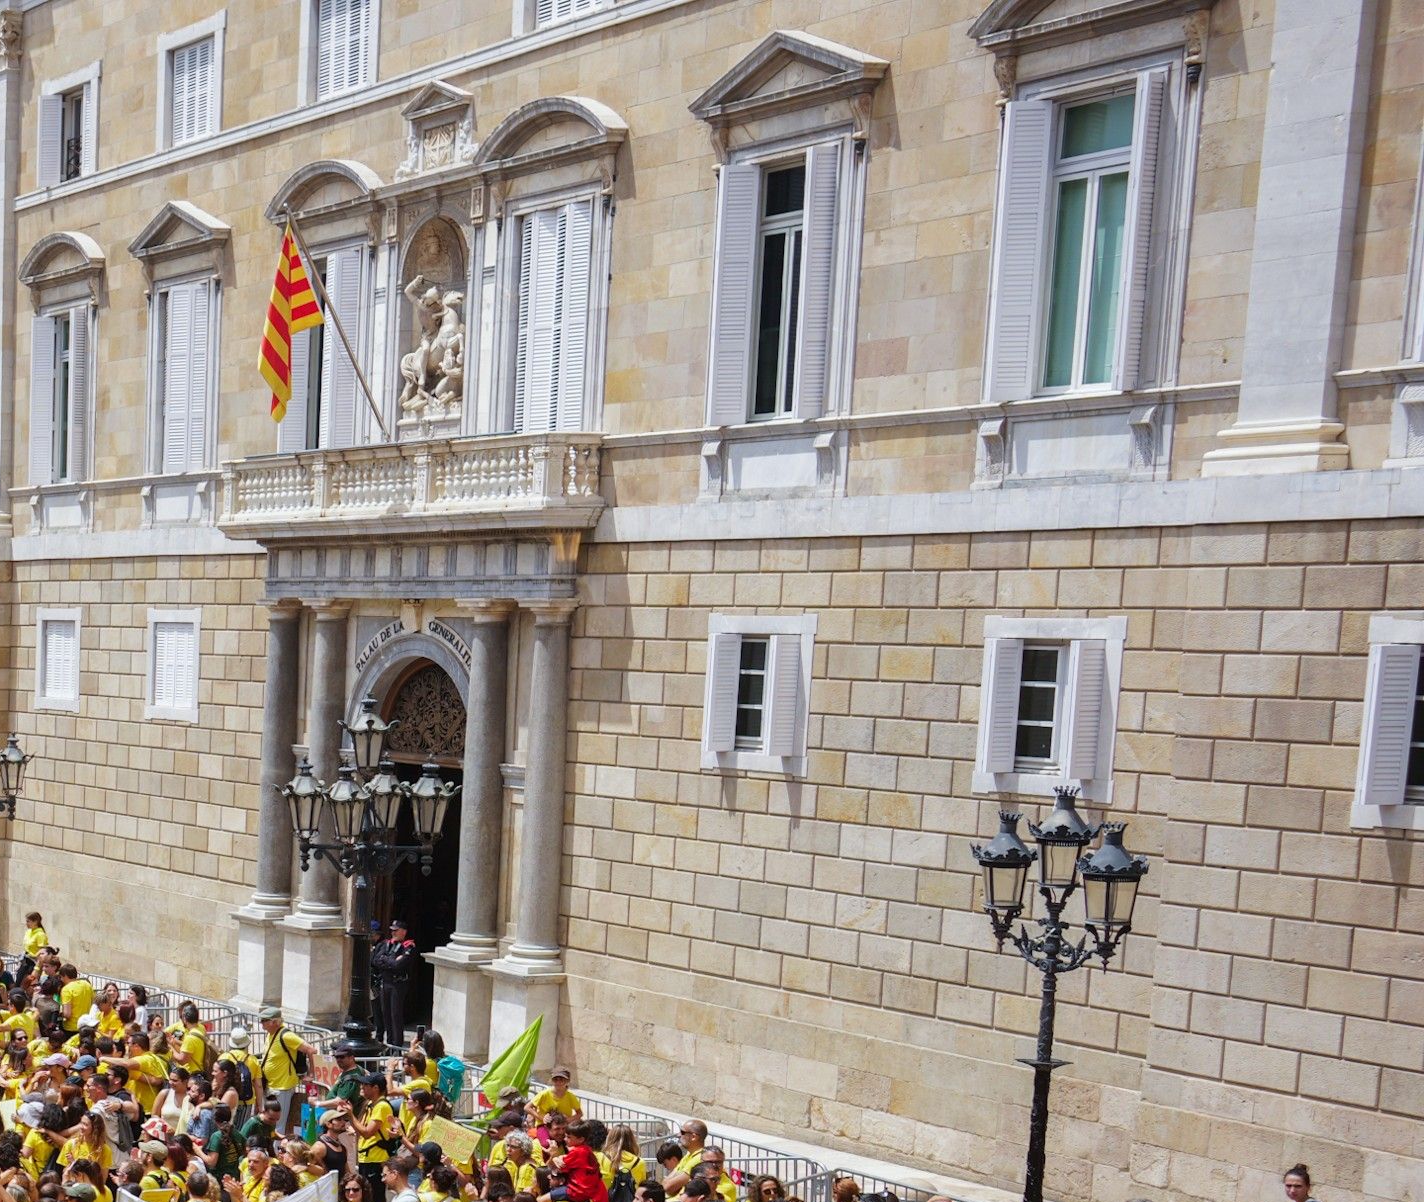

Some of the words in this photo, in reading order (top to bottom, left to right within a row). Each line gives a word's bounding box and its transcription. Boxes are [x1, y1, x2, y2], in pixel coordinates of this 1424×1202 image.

[356, 640, 379, 672] PALAU
[380, 627, 392, 643] DE
[392, 622, 405, 634] LA
